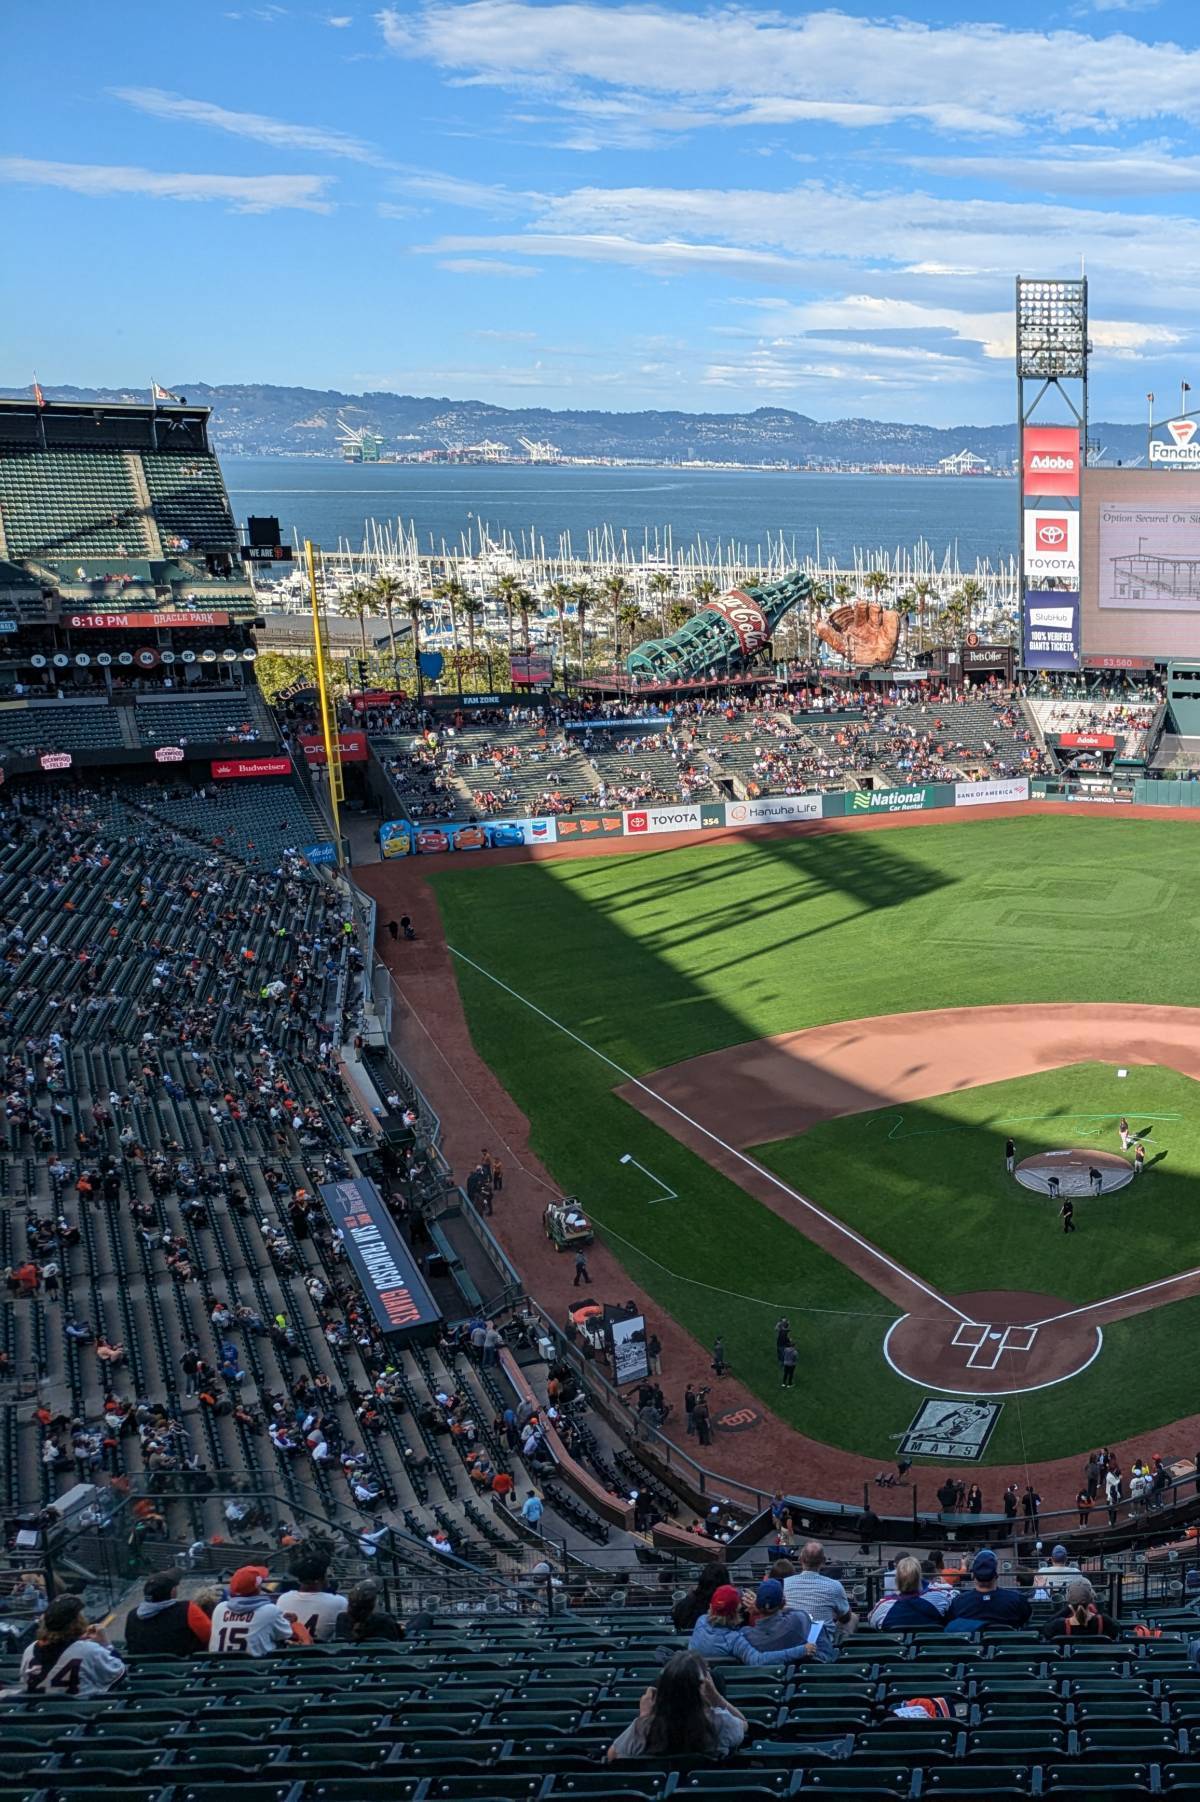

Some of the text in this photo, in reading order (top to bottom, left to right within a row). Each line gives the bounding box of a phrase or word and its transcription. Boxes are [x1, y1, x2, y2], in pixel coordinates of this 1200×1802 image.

[1030, 455, 1074, 469] Adobe
[1103, 513, 1132, 523] Option
[1135, 514, 1168, 523] Secured
[1172, 514, 1186, 523] On
[249, 548, 260, 558] WE
[261, 548, 273, 558] ARE
[1028, 558, 1075, 569] TOYOTA
[72, 616, 128, 627] 6:16 PM
[154, 613, 214, 625] ORACLE PARK
[1035, 613, 1068, 622] StubHub
[1031, 631, 1073, 642] 100% VERIFIED
[1029, 641, 1074, 652] GIANTS TICKETS
[985, 651, 1002, 662] Coffee
[480, 696, 500, 704] ZONE
[1076, 736, 1098, 744] Adobe
[303, 743, 360, 754] ORCLE
[238, 763, 285, 773] Budweiser
[871, 790, 925, 806] National
[750, 803, 817, 817] Hanwha Life
[902, 803, 924, 811] Rental
[652, 813, 698, 825] TOYOTA
[702, 818, 719, 826] 354
[350, 1224, 382, 1243] SAN
[358, 1241, 405, 1290] FRANCISCO
[379, 1288, 422, 1325] GIANTS
[963, 1407, 981, 1416] 24
[910, 1441, 972, 1456] MAYS
[218, 1627, 249, 1652] 15
[27, 1658, 83, 1695] 24
